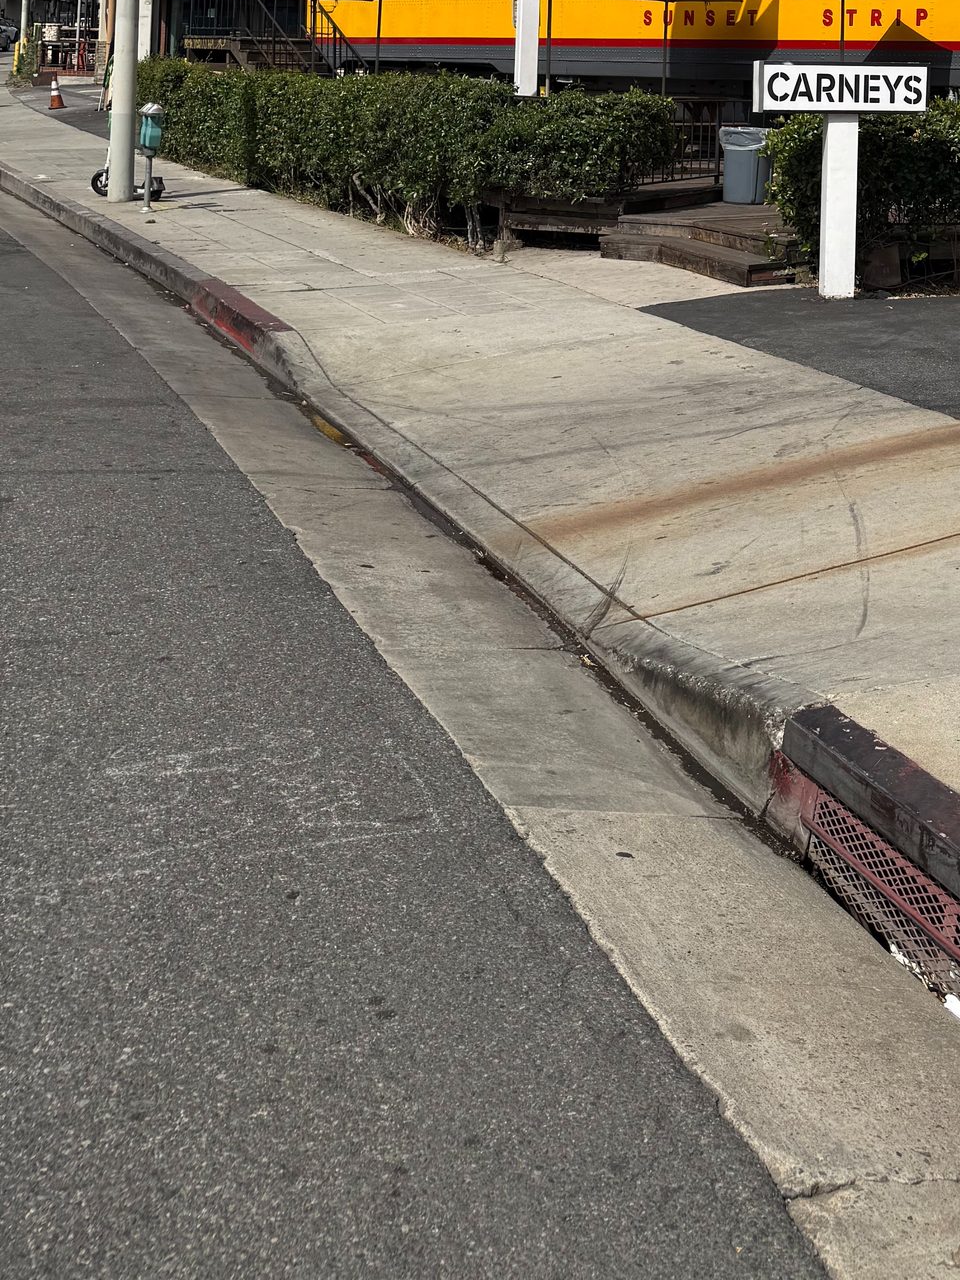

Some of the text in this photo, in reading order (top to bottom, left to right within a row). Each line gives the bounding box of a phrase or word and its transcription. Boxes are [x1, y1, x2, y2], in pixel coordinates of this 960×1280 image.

[643, 7, 929, 28] SUNSET STRIP
[766, 70, 923, 106] CARNEYS
